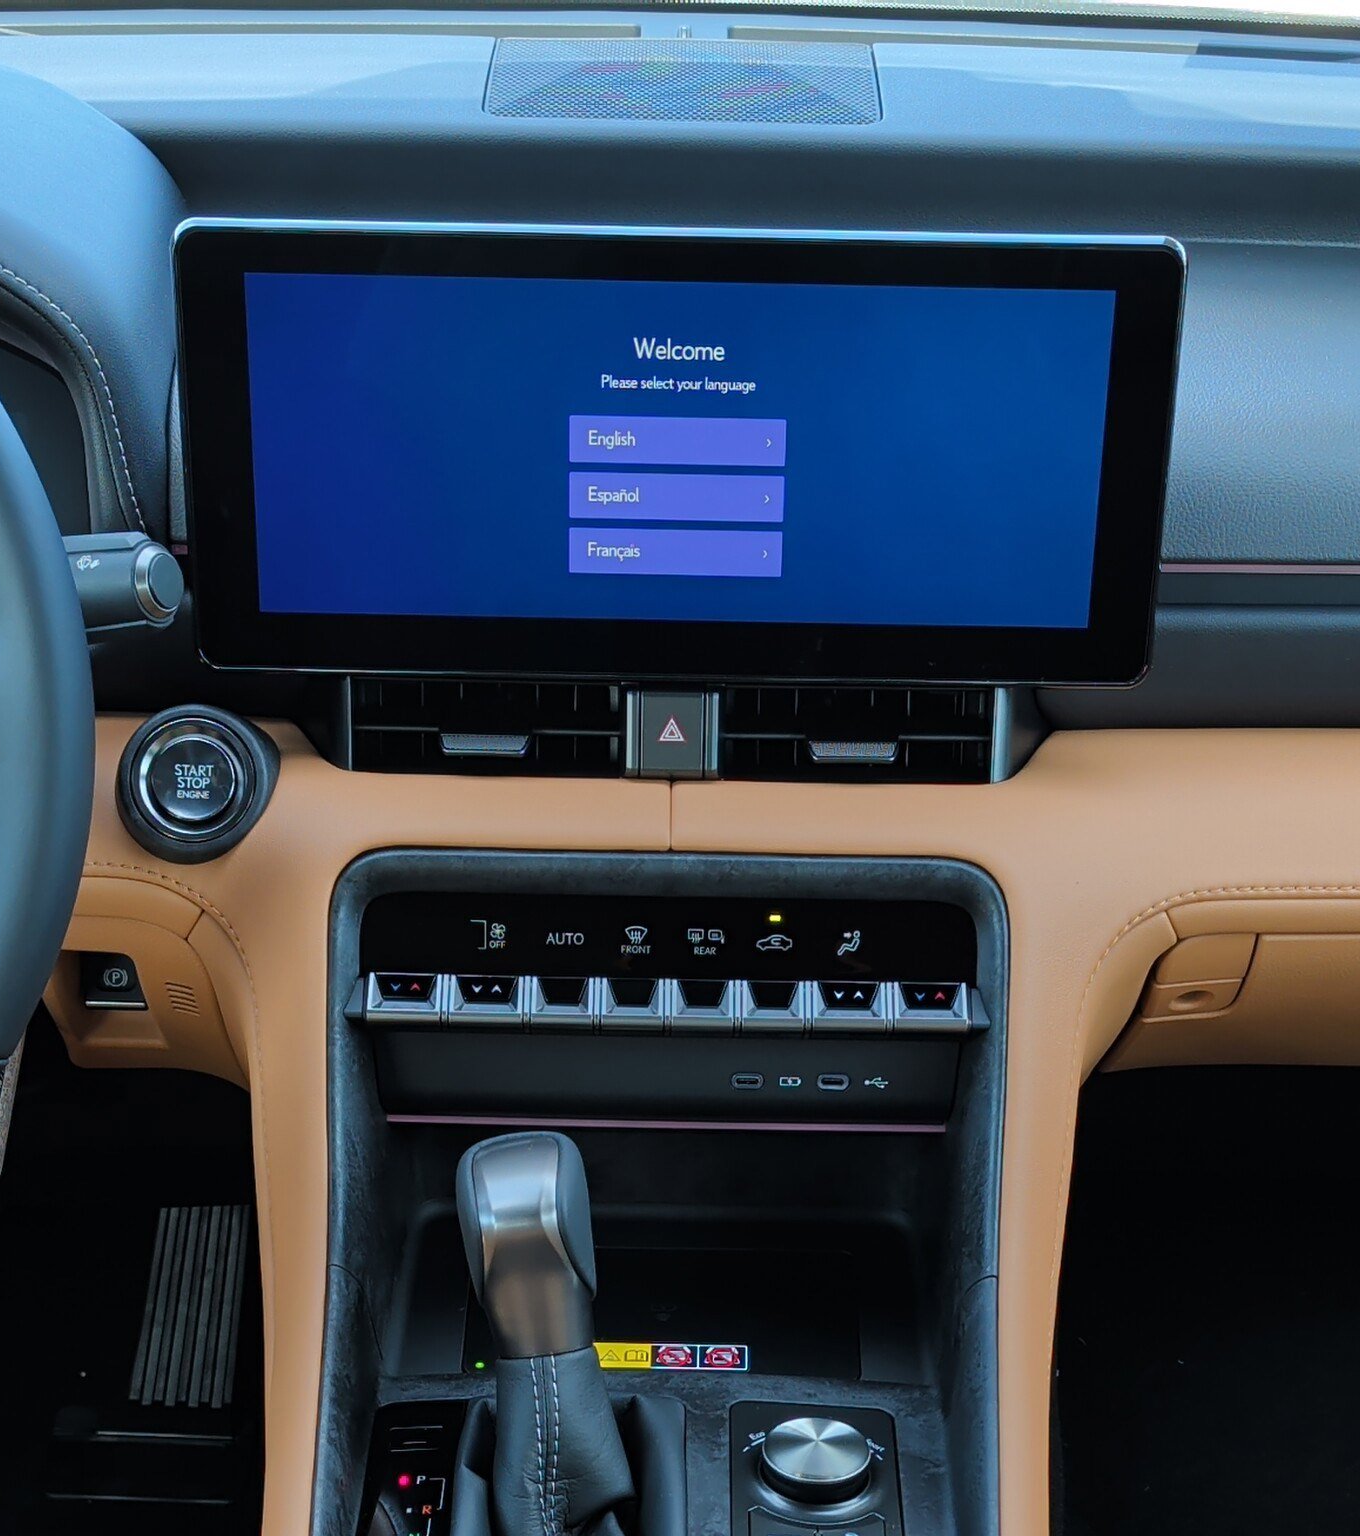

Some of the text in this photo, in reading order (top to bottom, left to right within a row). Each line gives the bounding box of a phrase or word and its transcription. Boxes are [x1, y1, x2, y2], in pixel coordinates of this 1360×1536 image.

[633, 337, 726, 361] Welcome
[601, 373, 757, 394] Please select your language
[588, 430, 636, 449] English
[588, 486, 640, 505] Español
[587, 541, 641, 561] Français
[174, 763, 214, 777] START
[177, 776, 211, 789] STOP
[176, 790, 210, 800] ENGINE
[488, 940, 507, 950] OFF
[545, 931, 585, 946] AUTO
[620, 944, 651, 954] FRONT
[693, 946, 717, 956] REAR
[416, 1475, 427, 1485] P
[422, 1505, 432, 1515] R
